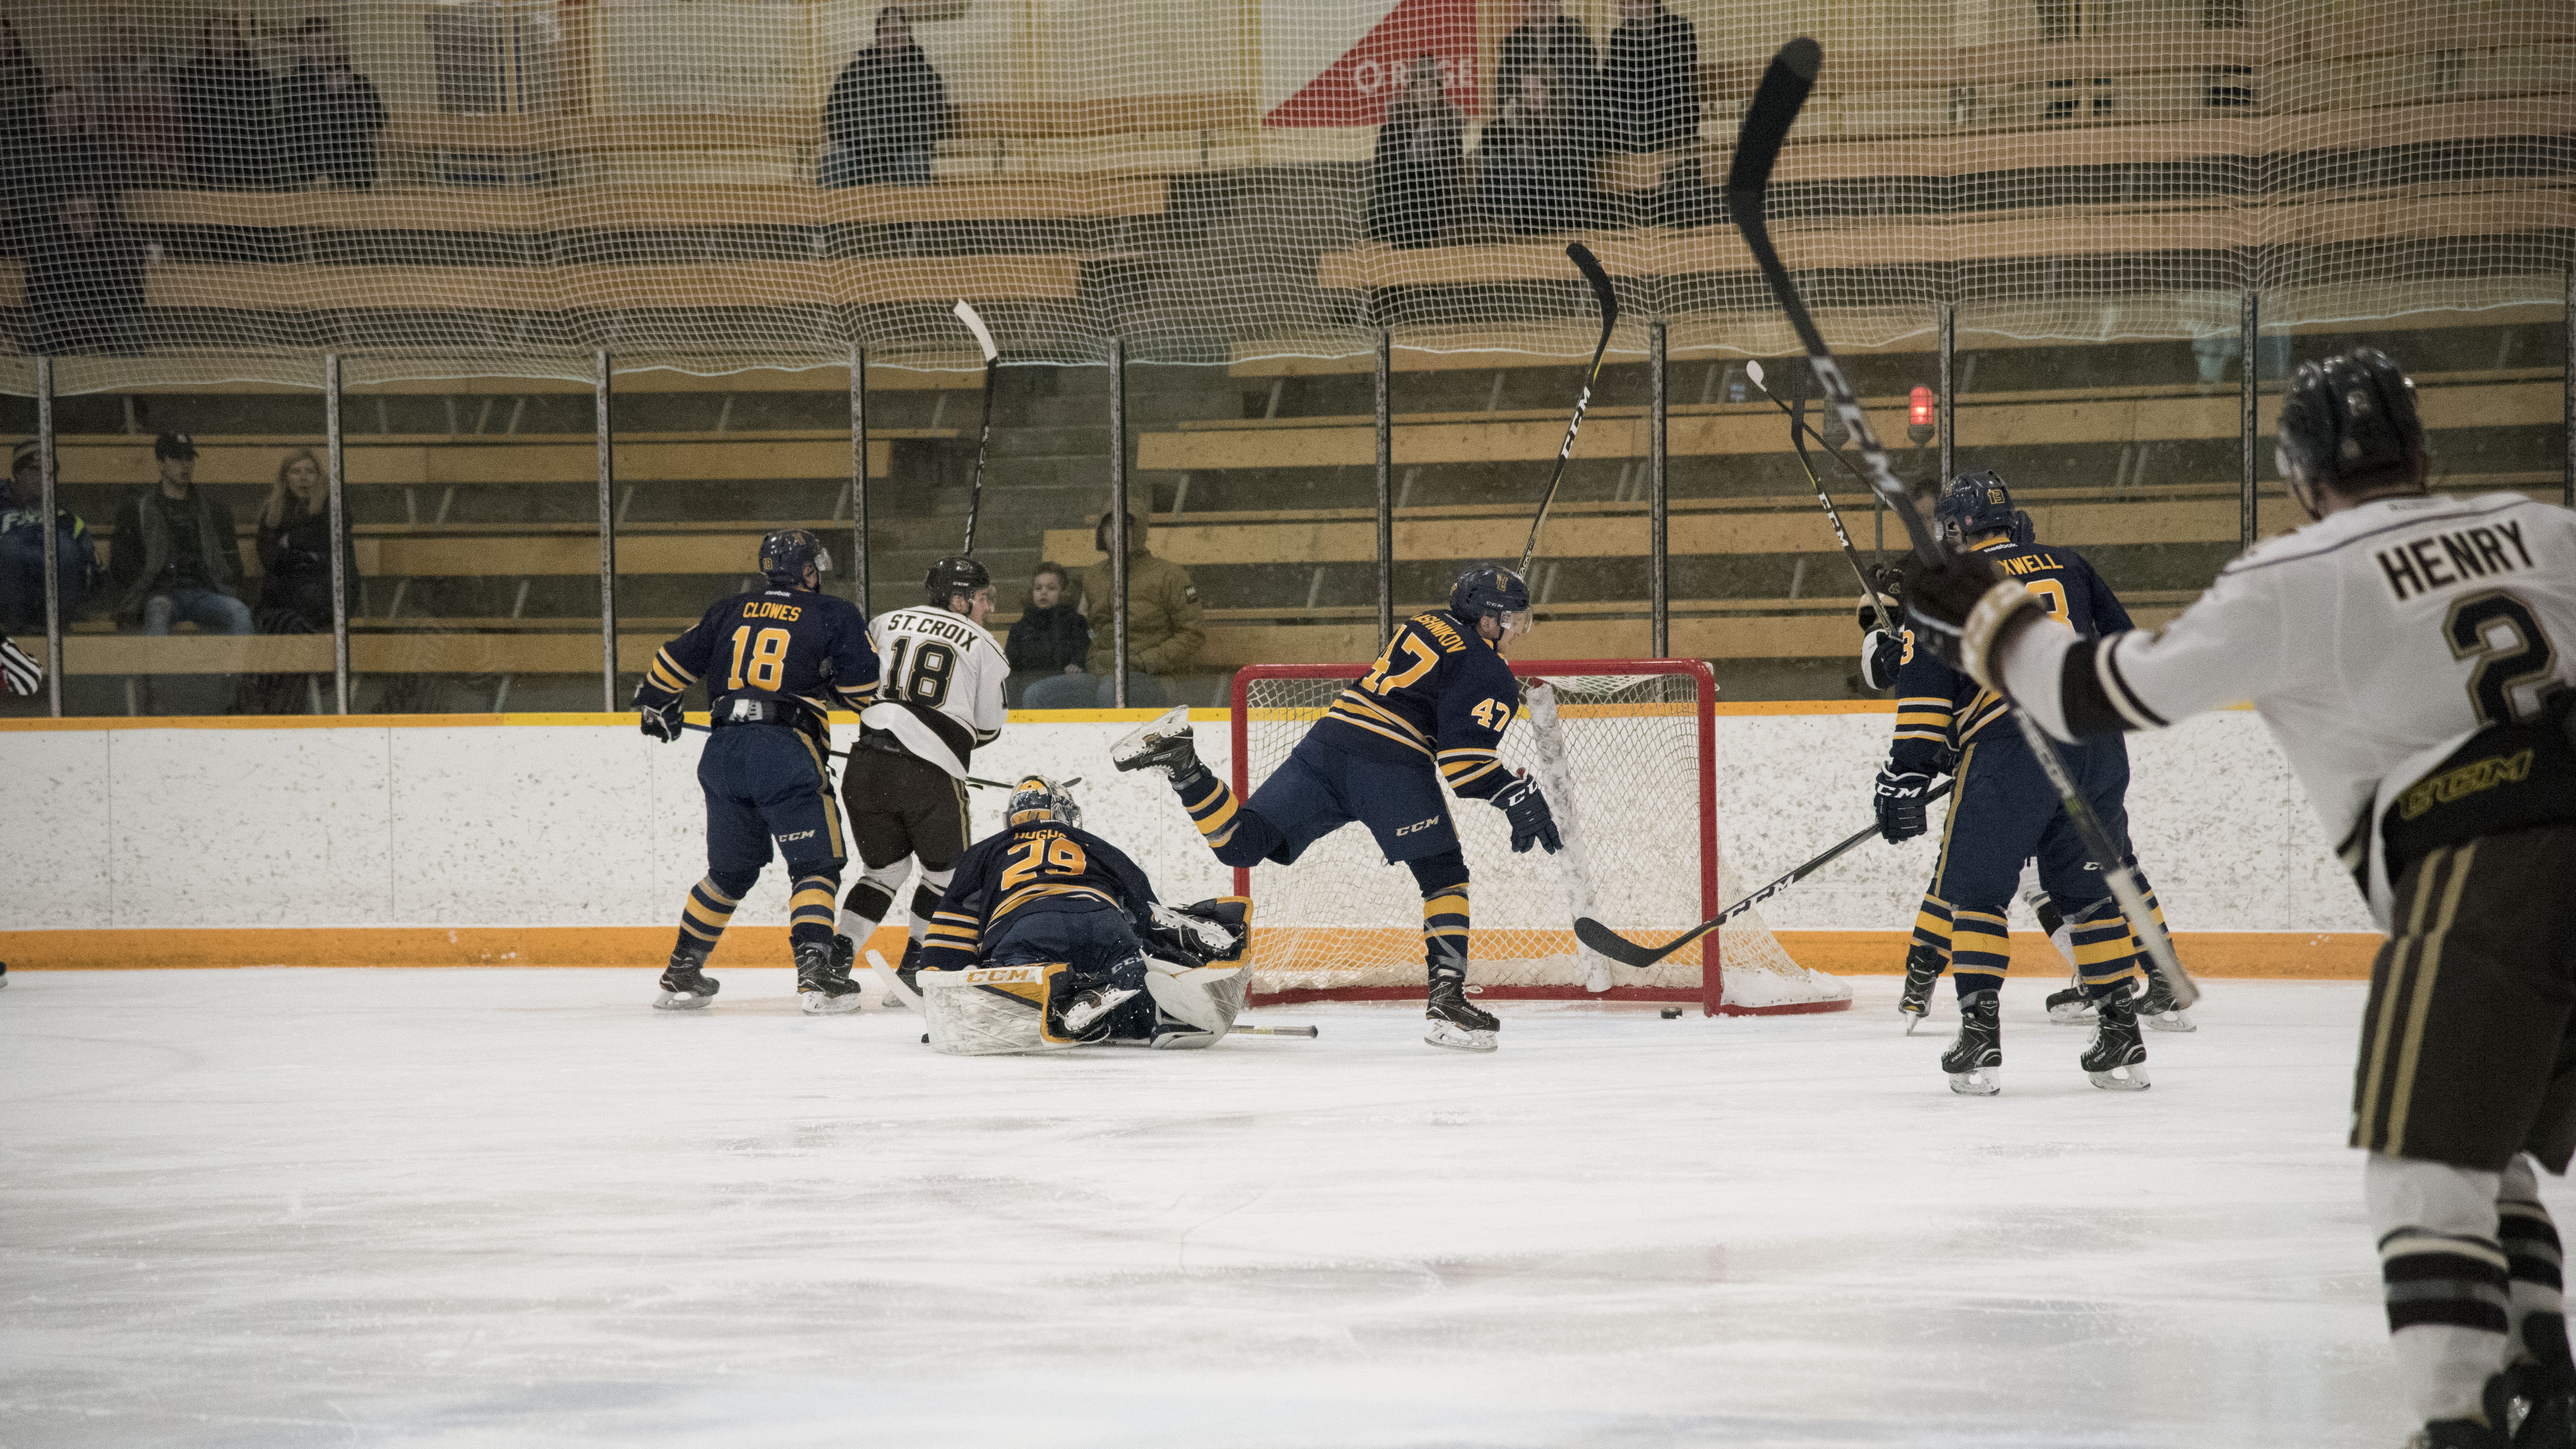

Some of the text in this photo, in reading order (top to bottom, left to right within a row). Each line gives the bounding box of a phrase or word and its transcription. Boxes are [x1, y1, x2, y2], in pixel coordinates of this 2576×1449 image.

[1561, 386, 1591, 459] CCM
[1987, 489, 2005, 504] 13
[1818, 492, 1849, 547] CCM
[1519, 549, 1532, 579] ACKS
[1983, 542, 2018, 553] Reebok
[2375, 519, 2534, 600] HENRY
[742, 602, 802, 622] CLOWES
[887, 614, 978, 652] ST. CROIX
[728, 626, 790, 692] 18
[882, 635, 957, 709] 18
[1360, 624, 1439, 696] 47
[1471, 698, 1511, 733] 47
[1508, 778, 1538, 807] CC
[1876, 782, 1923, 799] CM
[779, 829, 815, 842] CCM
[1396, 815, 1439, 837] CCM
[1001, 837, 1087, 891] 29
[1726, 874, 1795, 919] CCM
[967, 969, 1031, 983] CCM
